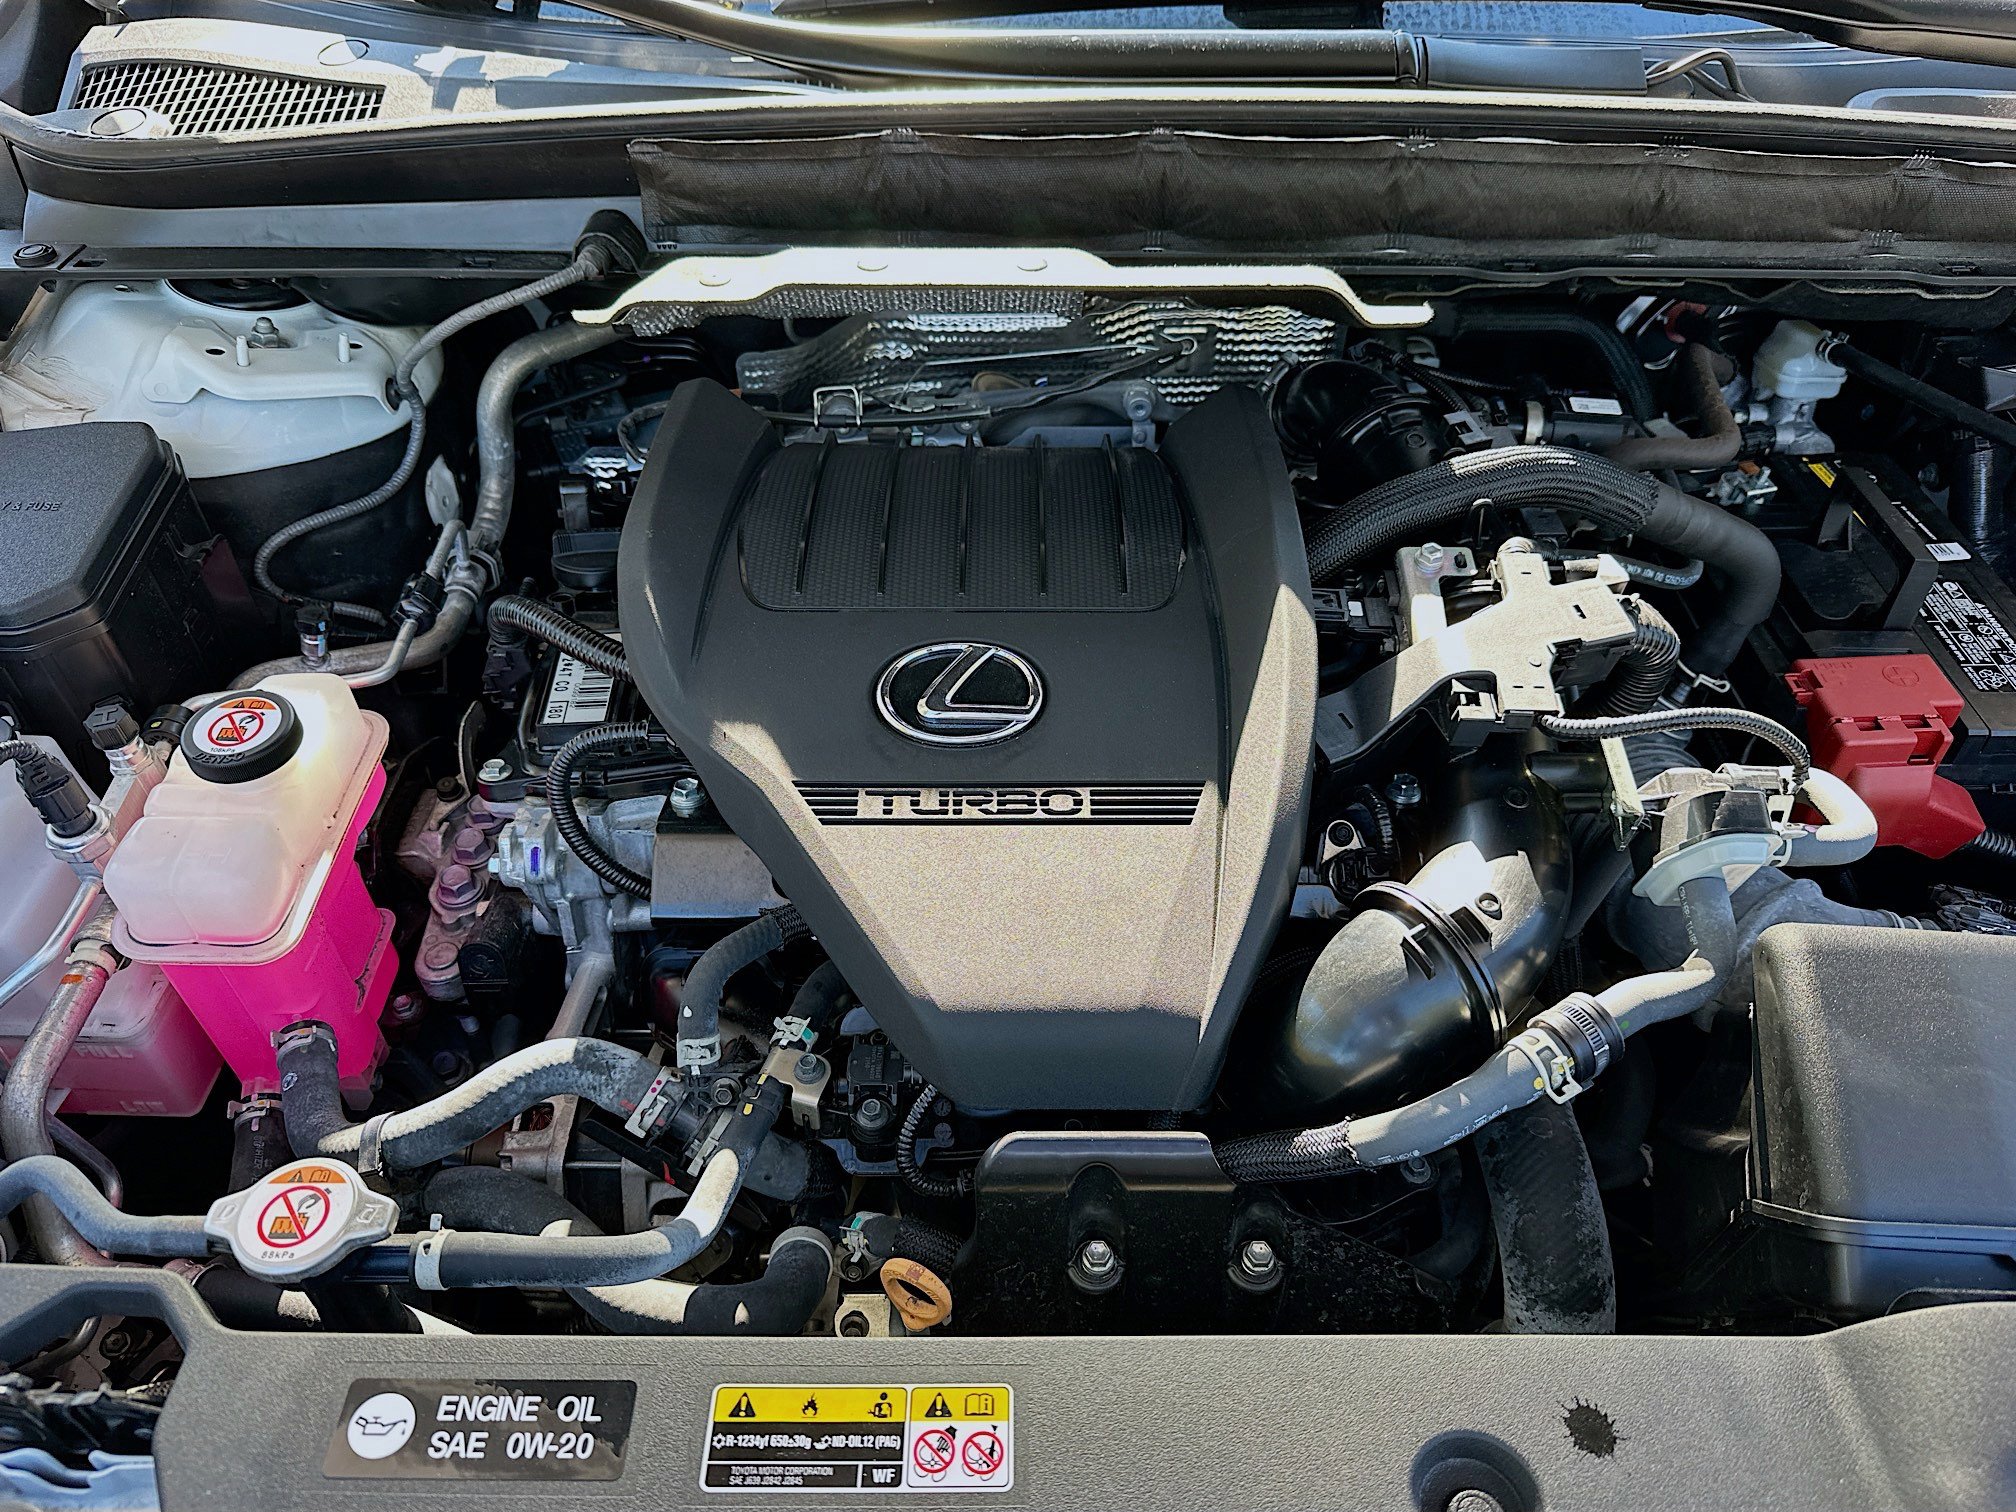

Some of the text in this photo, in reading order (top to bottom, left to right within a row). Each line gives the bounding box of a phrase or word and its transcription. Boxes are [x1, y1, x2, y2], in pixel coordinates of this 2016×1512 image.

[25, 501, 62, 511] FUSE
[192, 752, 247, 766] DENSO
[864, 788, 1085, 816] TURBO
[261, 1251, 295, 1260] 88kPa
[436, 1395, 602, 1422] ENGINE OIL
[427, 1431, 596, 1460] SAE 0W-20
[725, 1434, 770, 1450] R-1234yf
[874, 1435, 902, 1450] (PAG)
[730, 1466, 834, 1476] TOYOTA MOTOR CORPORATION
[871, 1468, 896, 1483] WF
[728, 1475, 744, 1485] SAE
